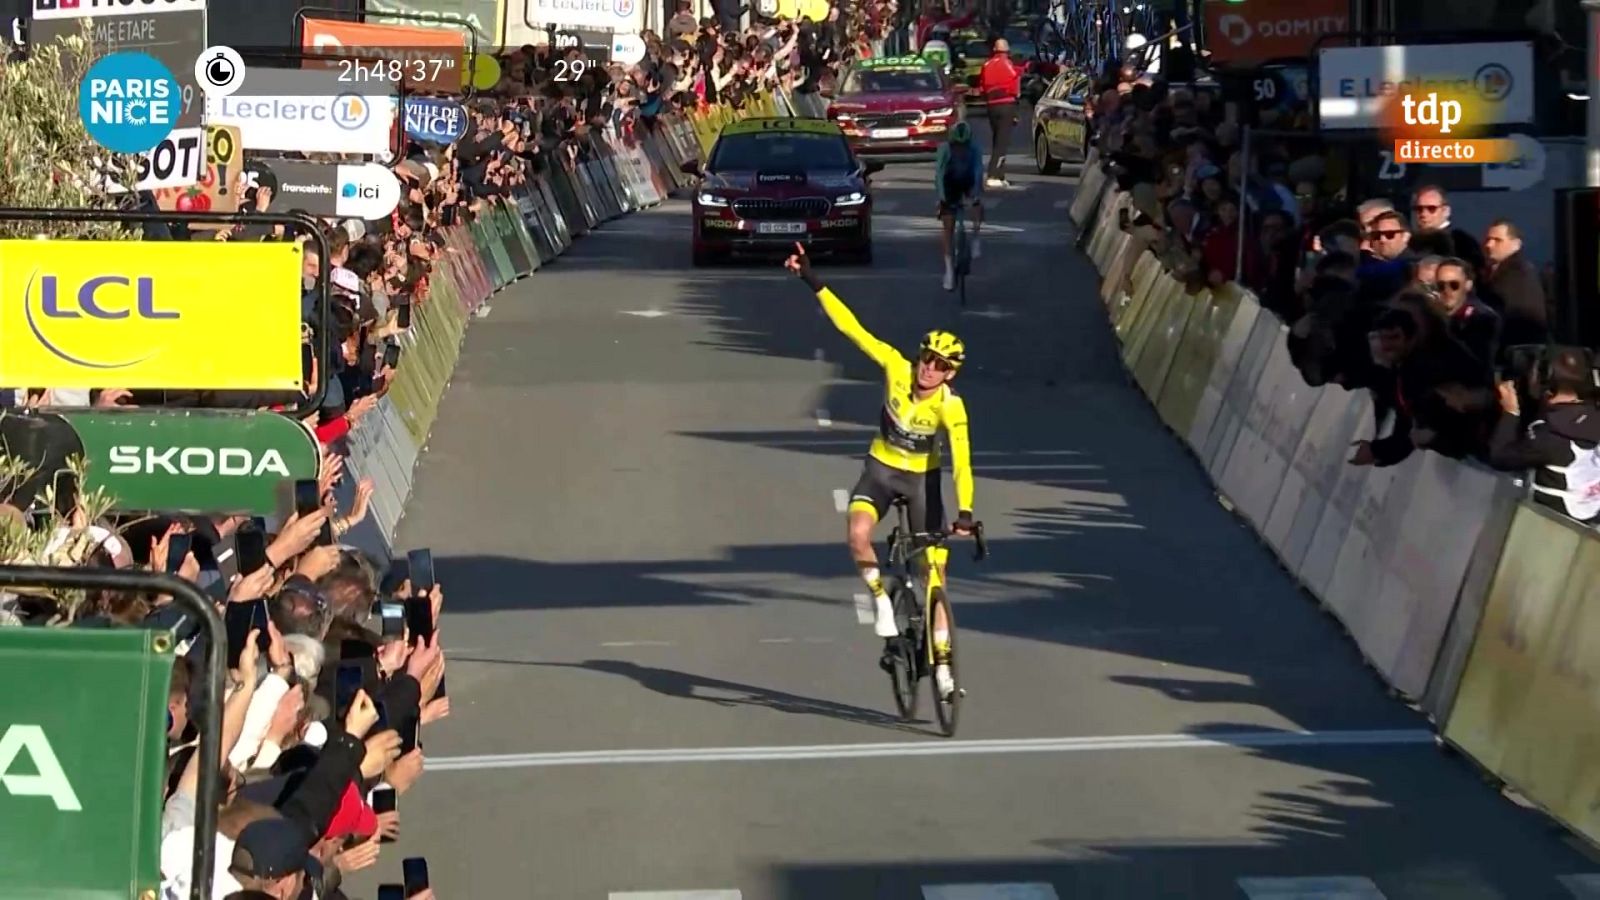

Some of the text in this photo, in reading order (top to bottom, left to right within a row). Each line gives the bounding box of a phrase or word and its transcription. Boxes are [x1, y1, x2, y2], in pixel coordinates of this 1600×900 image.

[1253, 77, 1275, 101] 50
[404, 115, 459, 137] NICE
[359, 183, 380, 200] ici
[41, 275, 181, 320] LCL
[108, 445, 291, 478] SKODA
